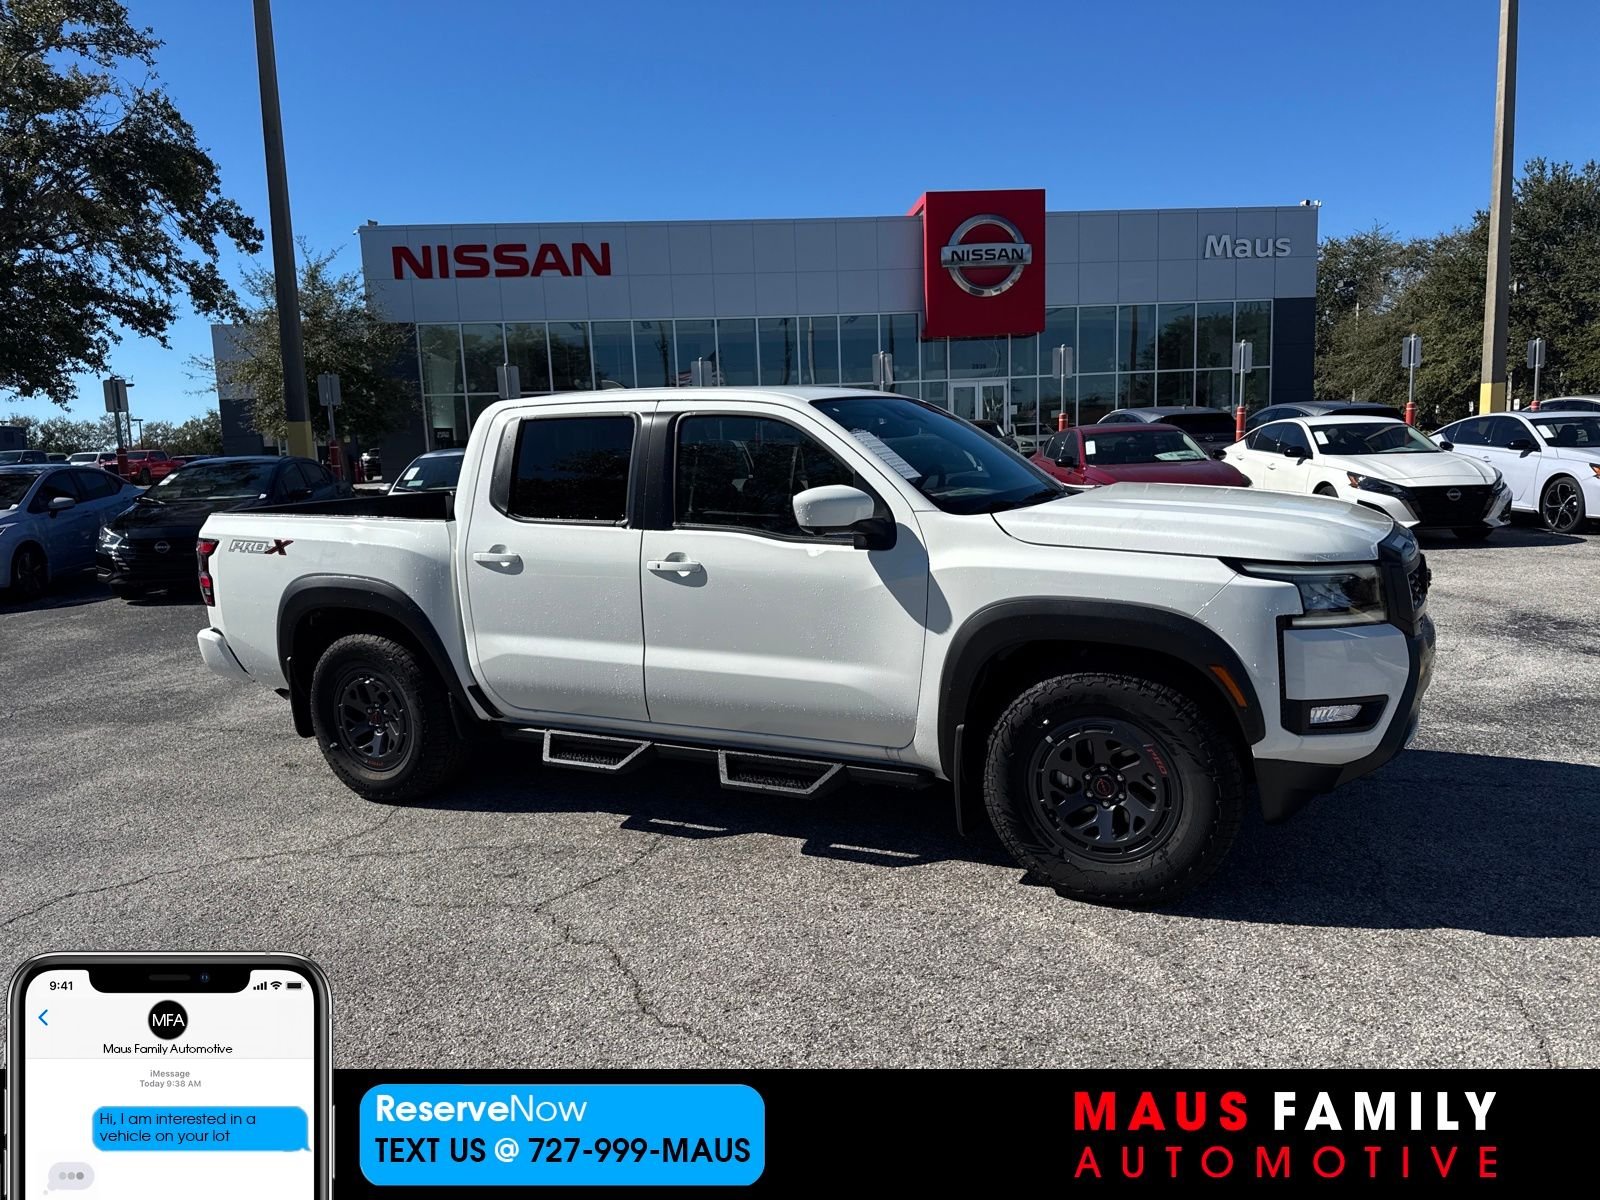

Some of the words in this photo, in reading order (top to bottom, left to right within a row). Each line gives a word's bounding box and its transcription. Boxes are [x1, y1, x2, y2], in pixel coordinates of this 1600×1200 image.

[951, 247, 1024, 262] NISSAN
[1203, 233, 1292, 260] Maus
[392, 242, 612, 280] NISSAN
